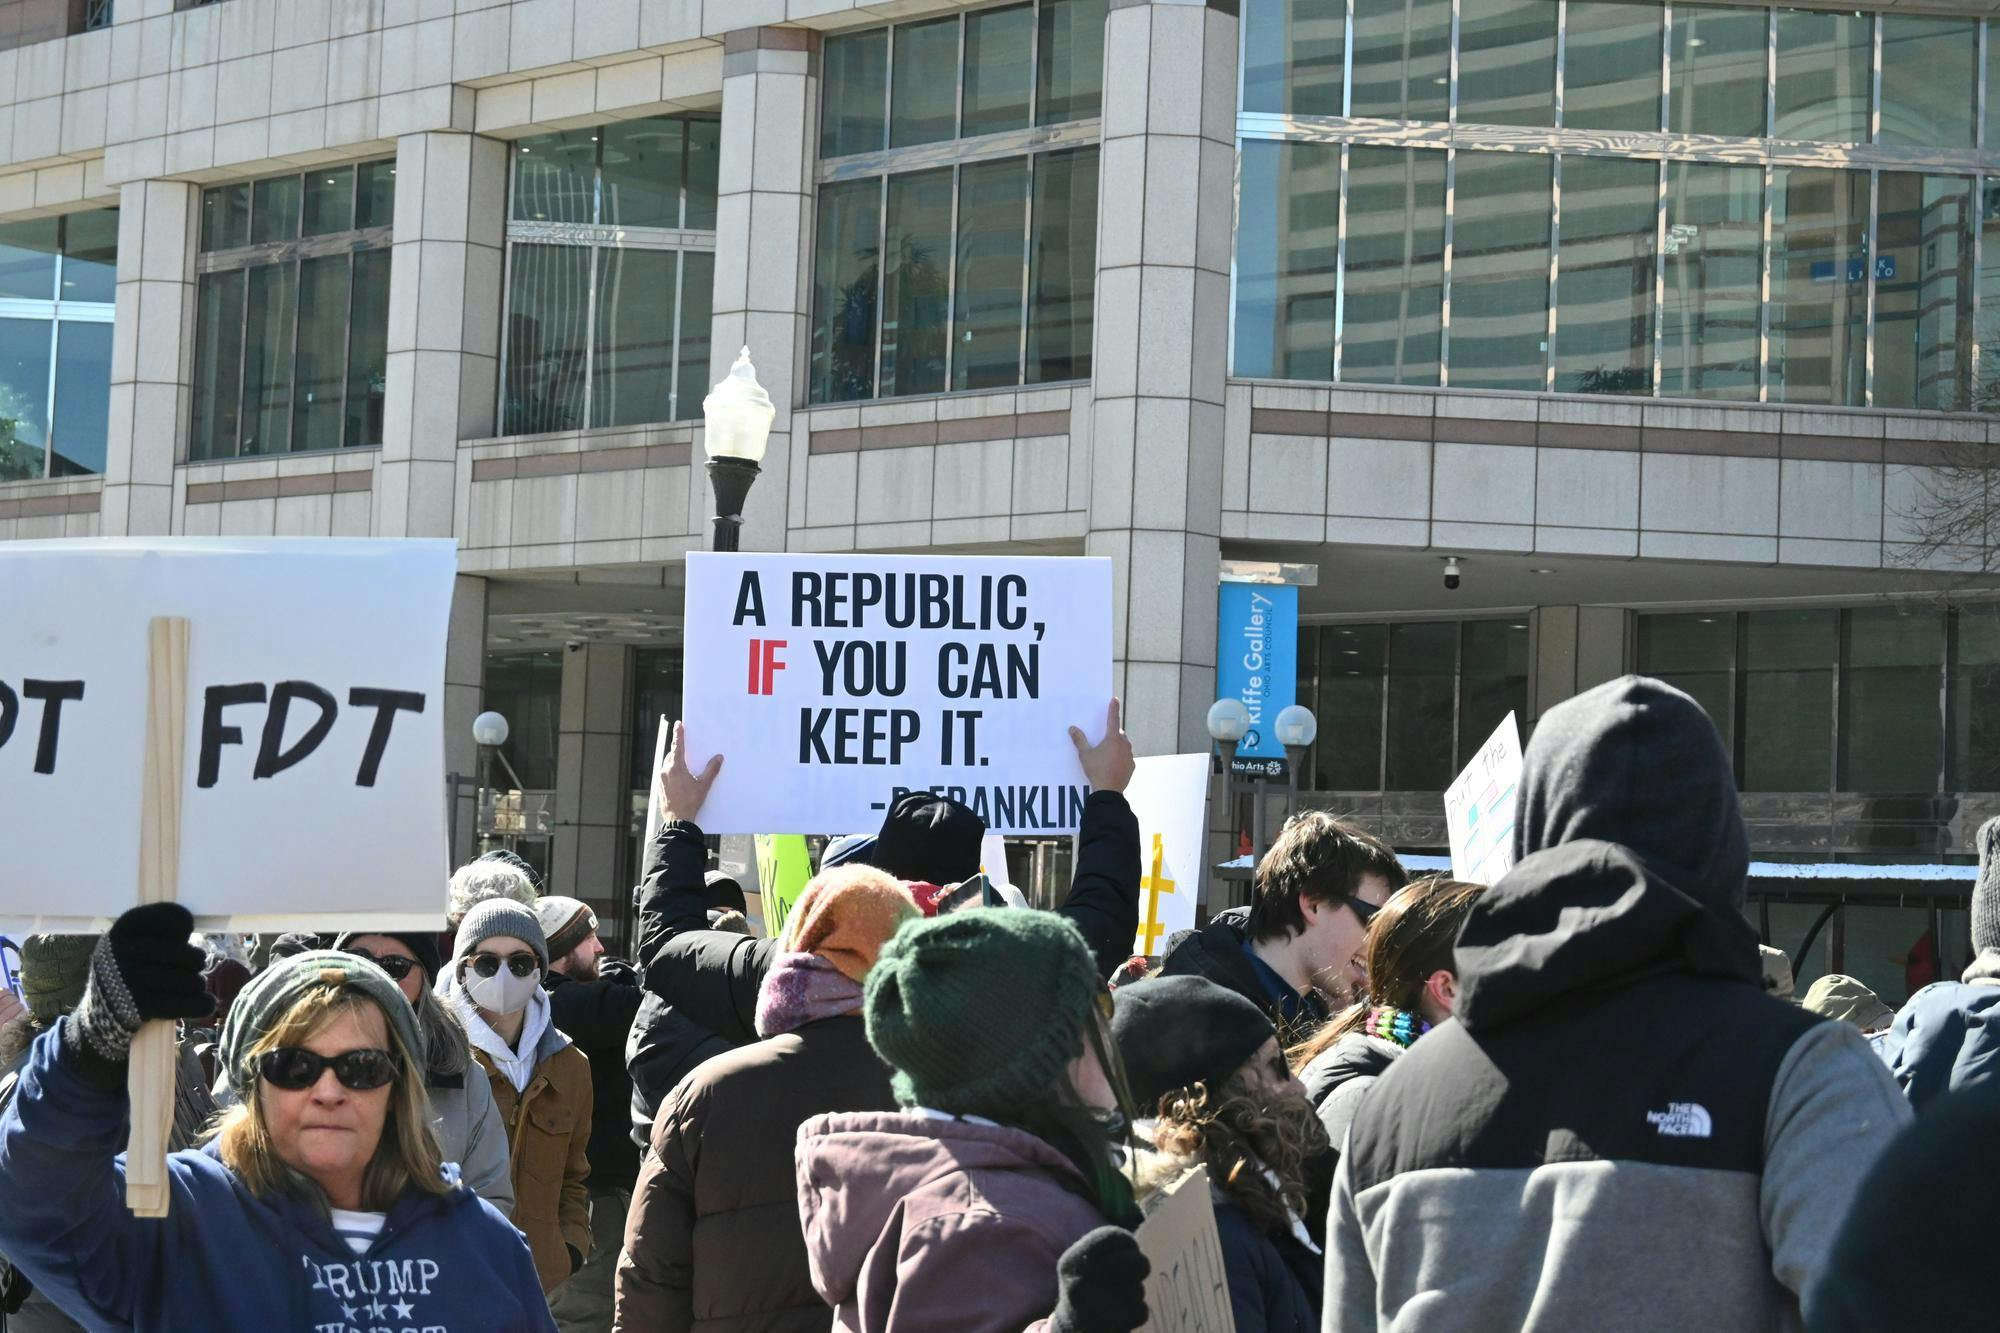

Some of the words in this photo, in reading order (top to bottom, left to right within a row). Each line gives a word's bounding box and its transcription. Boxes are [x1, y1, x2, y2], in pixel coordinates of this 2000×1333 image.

[733, 571, 766, 627] A
[791, 571, 1045, 641] REPUBLIC,
[1244, 592, 1272, 671] Gallery
[1264, 607, 1273, 651] COUNCIL
[747, 639, 787, 695] IF
[814, 640, 906, 697] YOU
[938, 642, 1040, 699] CAN
[1264, 653, 1272, 672] ARTS
[1263, 675, 1272, 698] OHIO
[0, 678, 85, 775] T
[197, 680, 425, 788] FDT
[799, 708, 920, 765] KEEP
[940, 710, 989, 767] IT.
[1246, 760, 1265, 771] Arts
[1481, 742, 1507, 776] the
[1646, 1110, 1691, 1124] NORTH
[1658, 1123, 1691, 1136] FACE
[1668, 1102, 1691, 1114] THE
[302, 1254, 440, 1299] TRUMP
